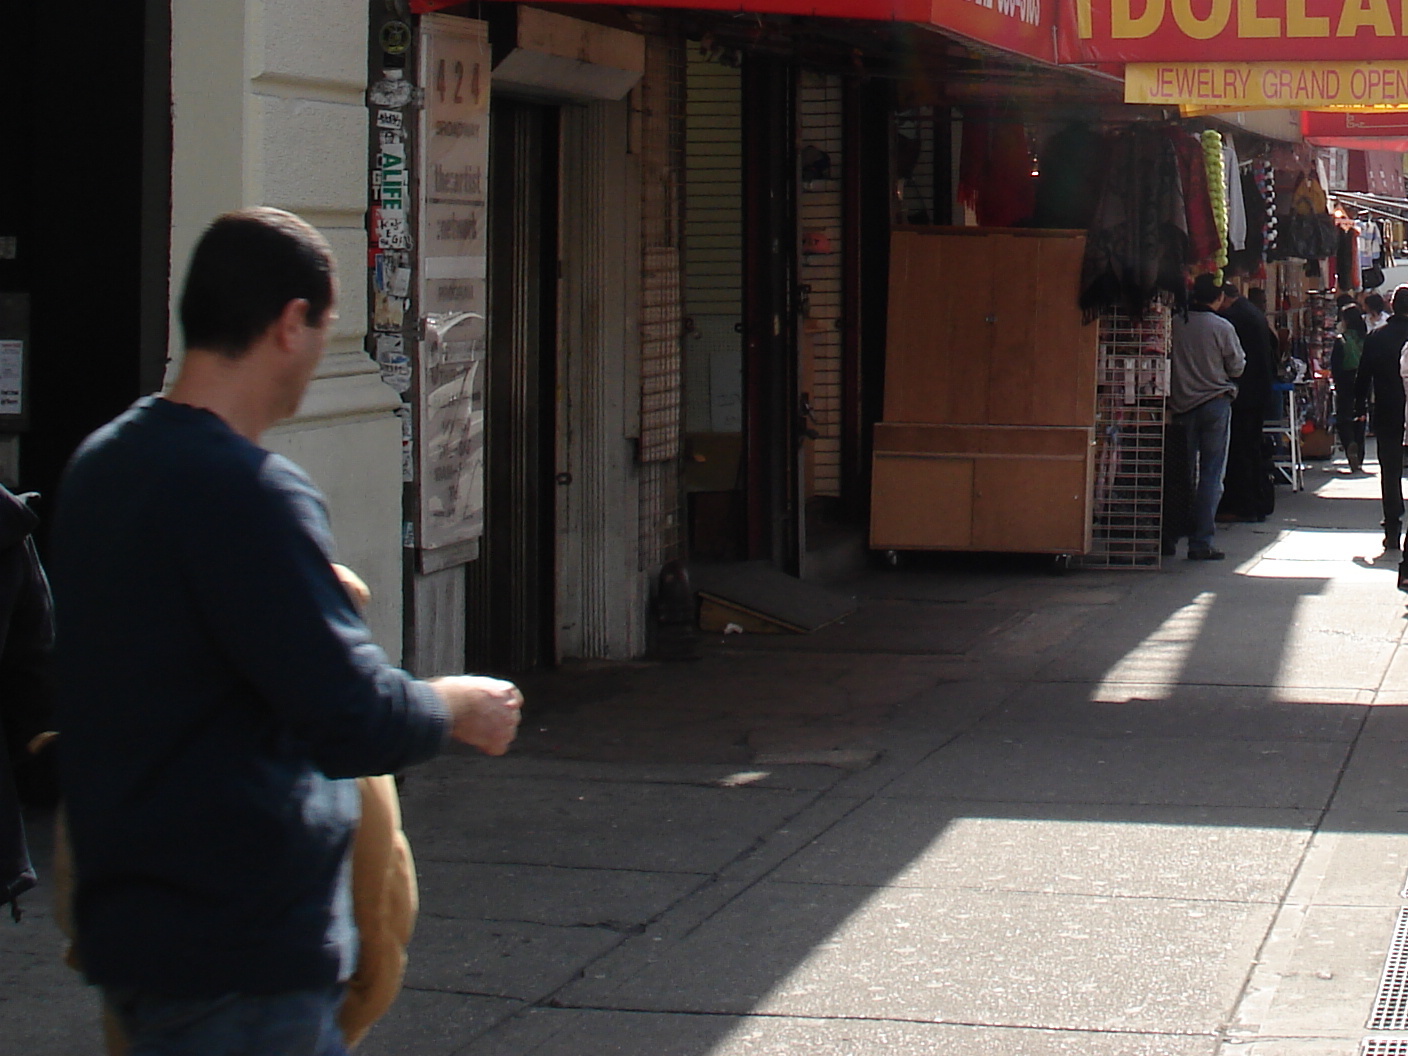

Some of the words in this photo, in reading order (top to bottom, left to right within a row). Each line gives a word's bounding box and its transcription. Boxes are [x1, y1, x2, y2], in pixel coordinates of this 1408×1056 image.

[1149, 68, 1251, 100] JEWELRY
[1262, 68, 1340, 99] GRAND
[383, 153, 402, 209] ALIFE
